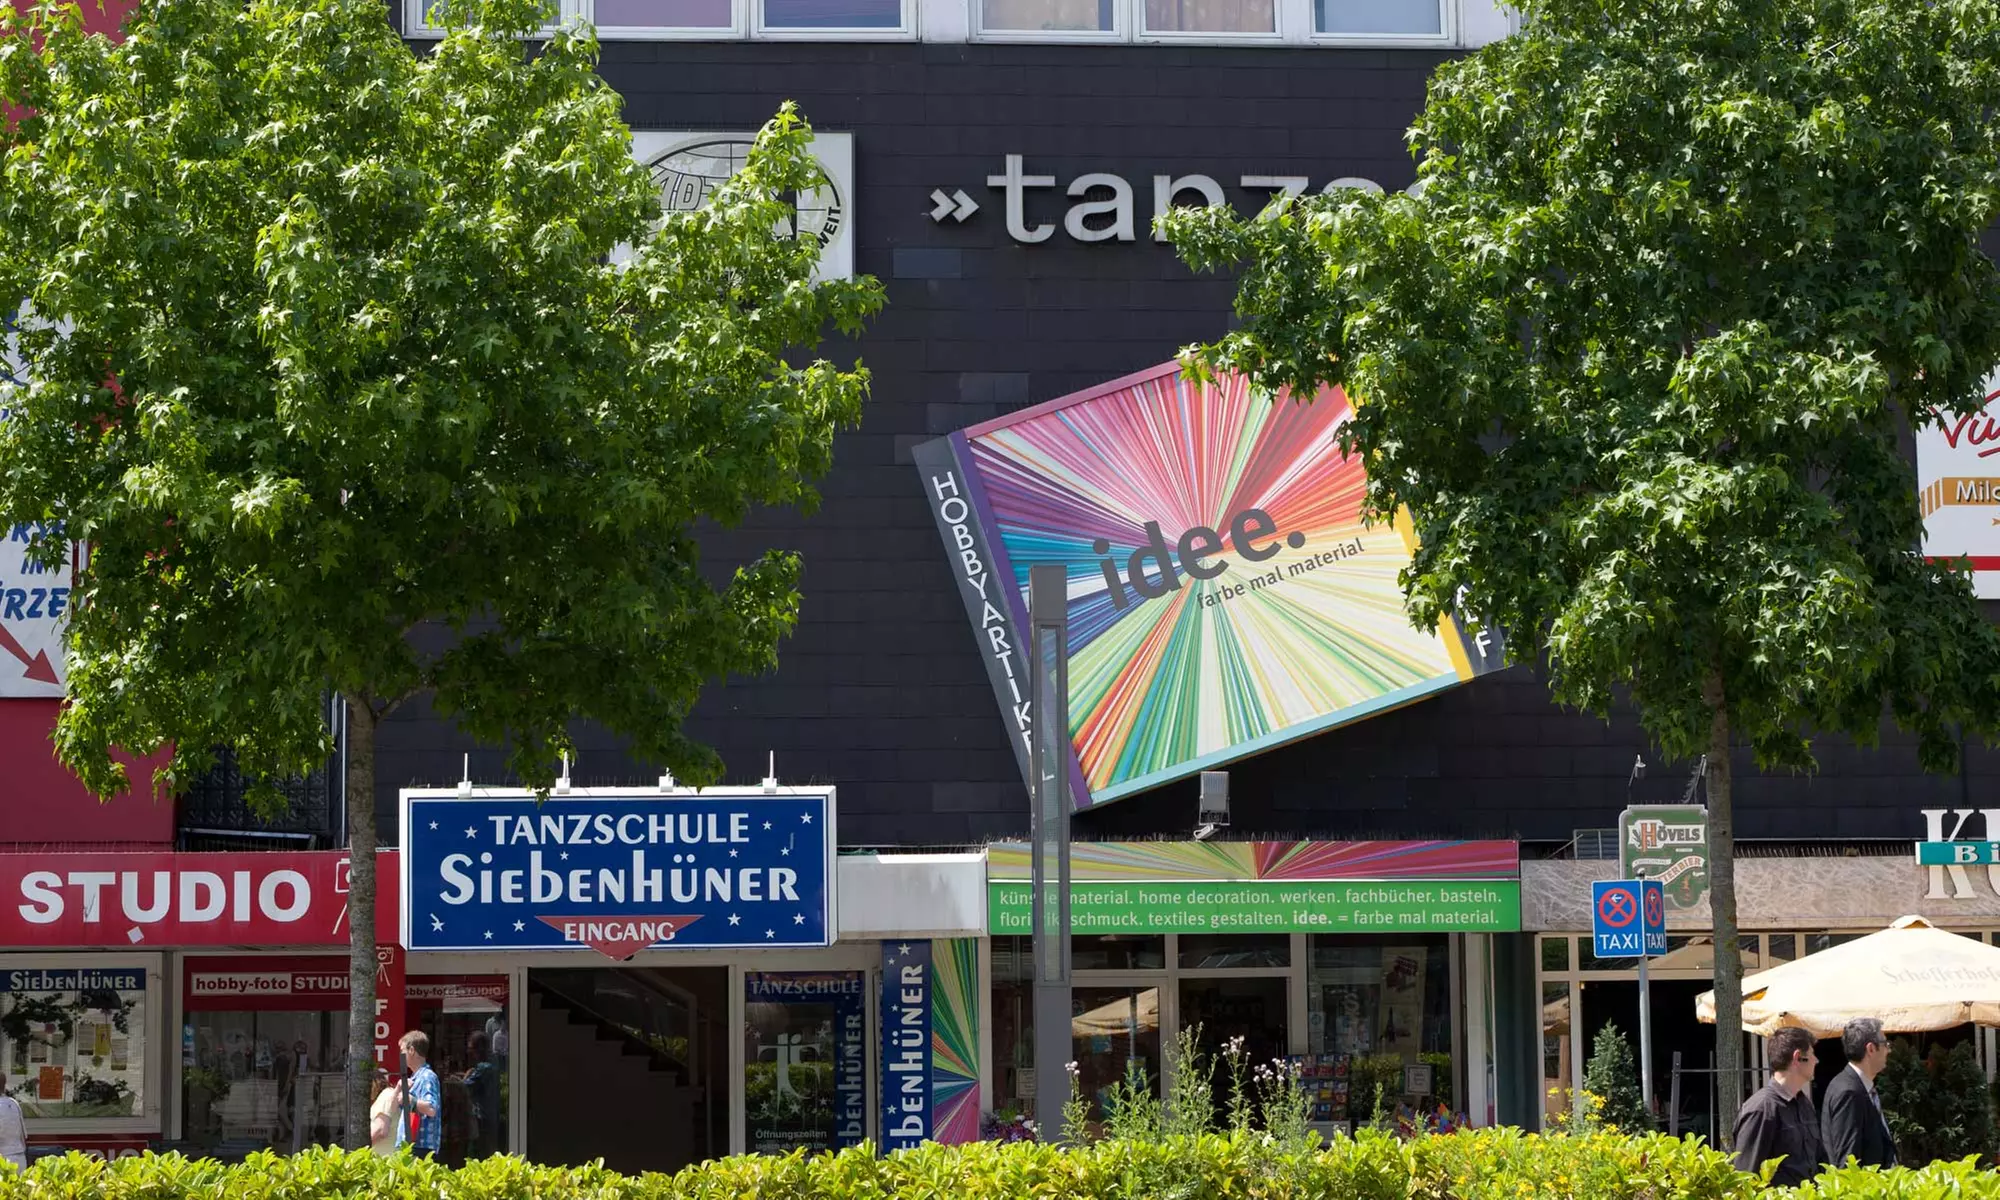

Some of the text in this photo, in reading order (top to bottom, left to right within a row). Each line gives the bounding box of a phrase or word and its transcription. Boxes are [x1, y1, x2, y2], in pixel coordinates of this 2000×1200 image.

[1092, 508, 1306, 612] idee.
[1196, 537, 1365, 610] farbe mal material
[0, 580, 70, 622] RZE
[932, 471, 1056, 783] HOBBYARTIKL
[488, 812, 750, 845] TANZSCHULE
[1640, 822, 1701, 852] HÖVELS
[18, 869, 311, 924] STUDIO
[1139, 890, 1181, 905] home
[1187, 890, 1274, 905] decoration.
[1280, 888, 1340, 904] werken.
[1346, 888, 1435, 904] fachbücher.
[1440, 888, 1502, 903] basteln.
[1070, 911, 1143, 927] schmuck.
[1148, 911, 1205, 926] textiles
[1210, 910, 1288, 929] gestalten.
[1292, 910, 1332, 925] idee.
[1354, 909, 1393, 925] farbe
[1399, 909, 1427, 924] mal
[1431, 909, 1499, 924] material.
[564, 922, 676, 942] EINGANG
[1598, 932, 1639, 950] TAXI
[1645, 932, 1665, 949] TAXI
[195, 976, 351, 992] hobby-foto STUDI
[750, 980, 860, 995] TANZSCHULE
[374, 999, 390, 1074] FOT
[755, 1128, 828, 1140] Öffnungszeiten
